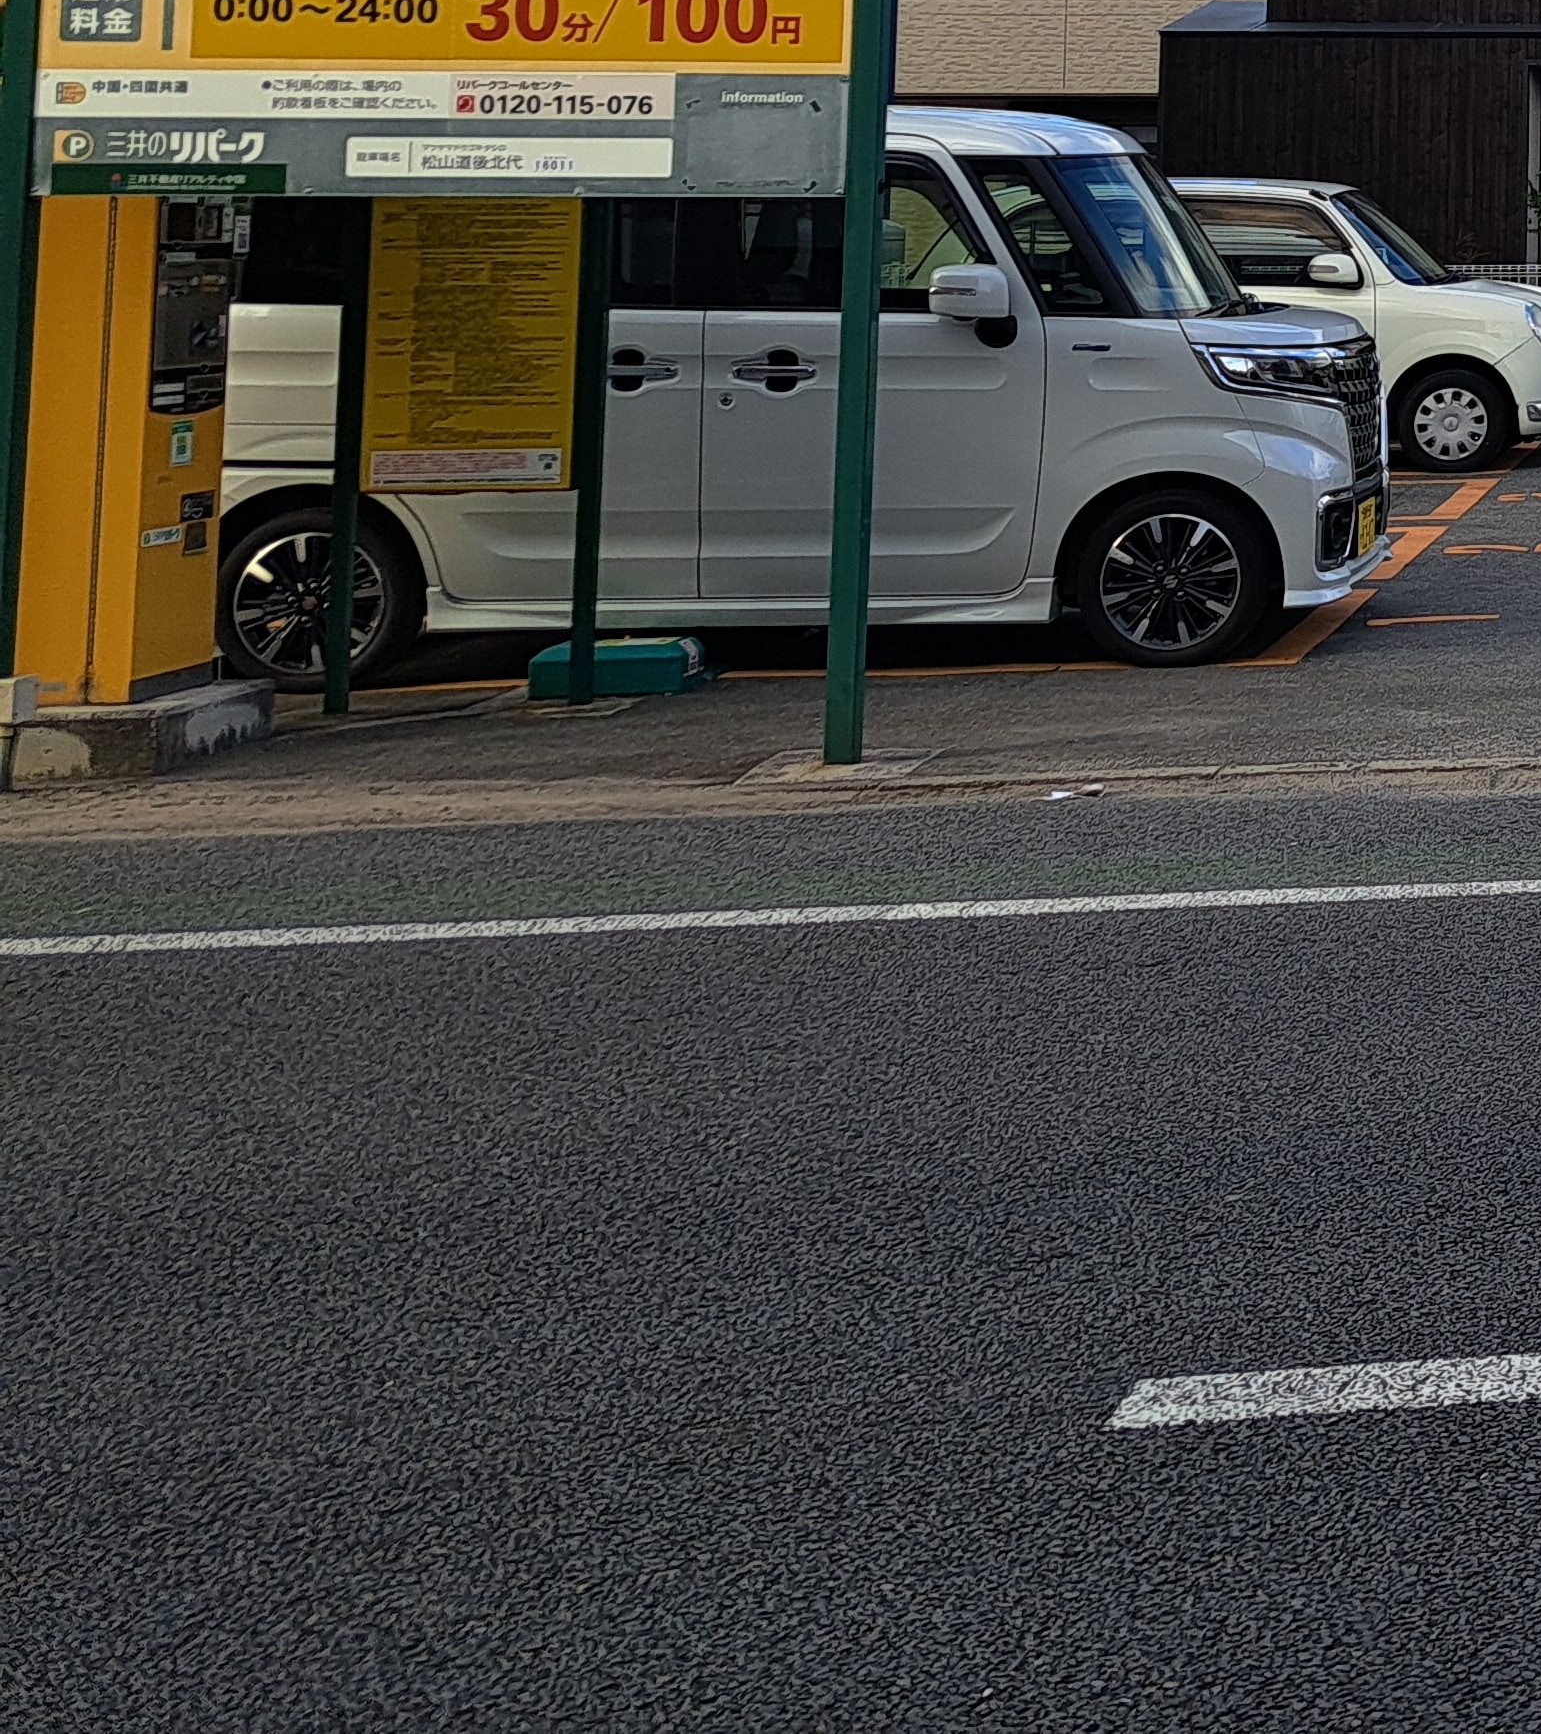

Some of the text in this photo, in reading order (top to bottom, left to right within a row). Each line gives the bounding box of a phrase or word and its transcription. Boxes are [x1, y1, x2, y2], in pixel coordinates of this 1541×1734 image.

[69, 7, 133, 35] 料金
[479, 93, 654, 117] 0120-115-076
[69, 136, 87, 156] P
[105, 127, 266, 164] 三井のリパーク
